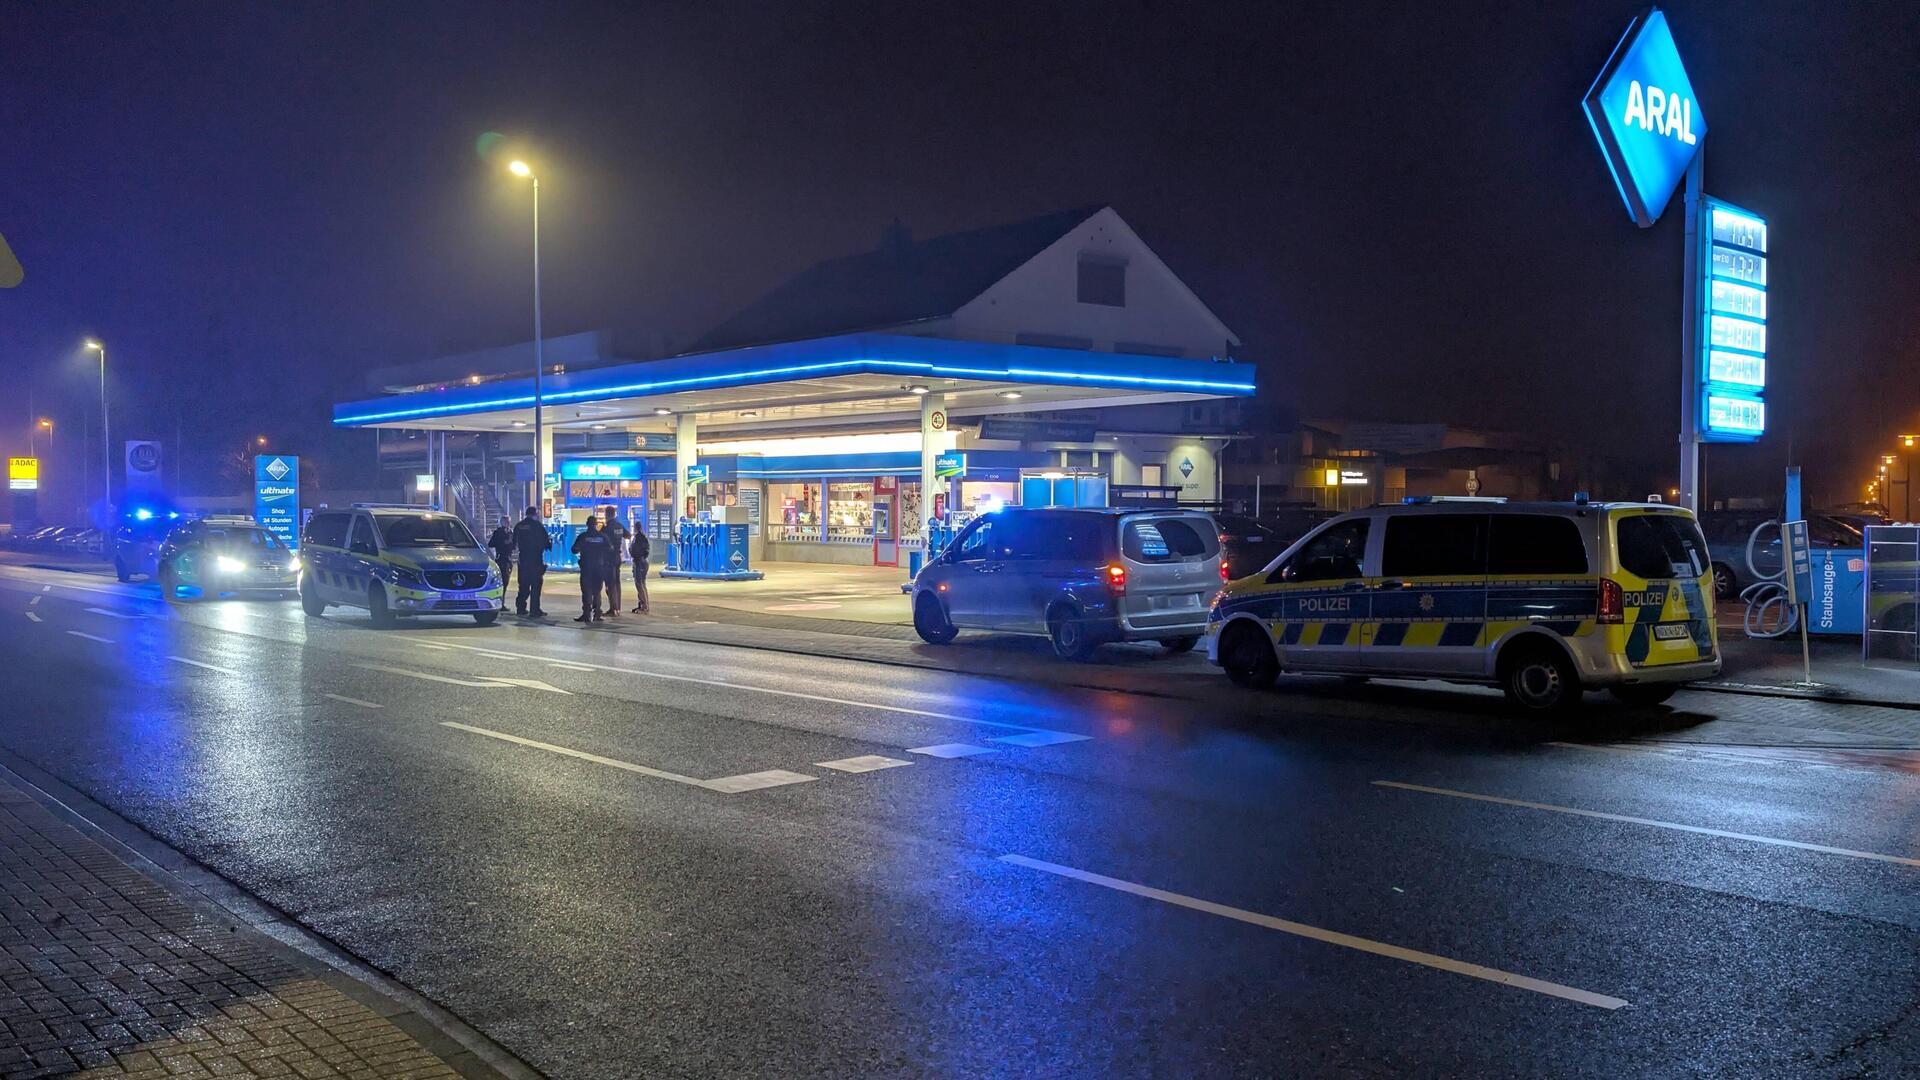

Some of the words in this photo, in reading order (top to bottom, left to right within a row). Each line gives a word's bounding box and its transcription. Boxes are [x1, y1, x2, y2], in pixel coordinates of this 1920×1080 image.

[1624, 80, 1696, 146] ARAL
[15, 459, 36, 467] ADAC
[597, 464, 621, 477] Shop
[260, 487, 295, 495] ultimate
[271, 508, 286, 516] Shop
[1299, 596, 1351, 612] POLIZEI
[1624, 591, 1664, 607] POLIZEI
